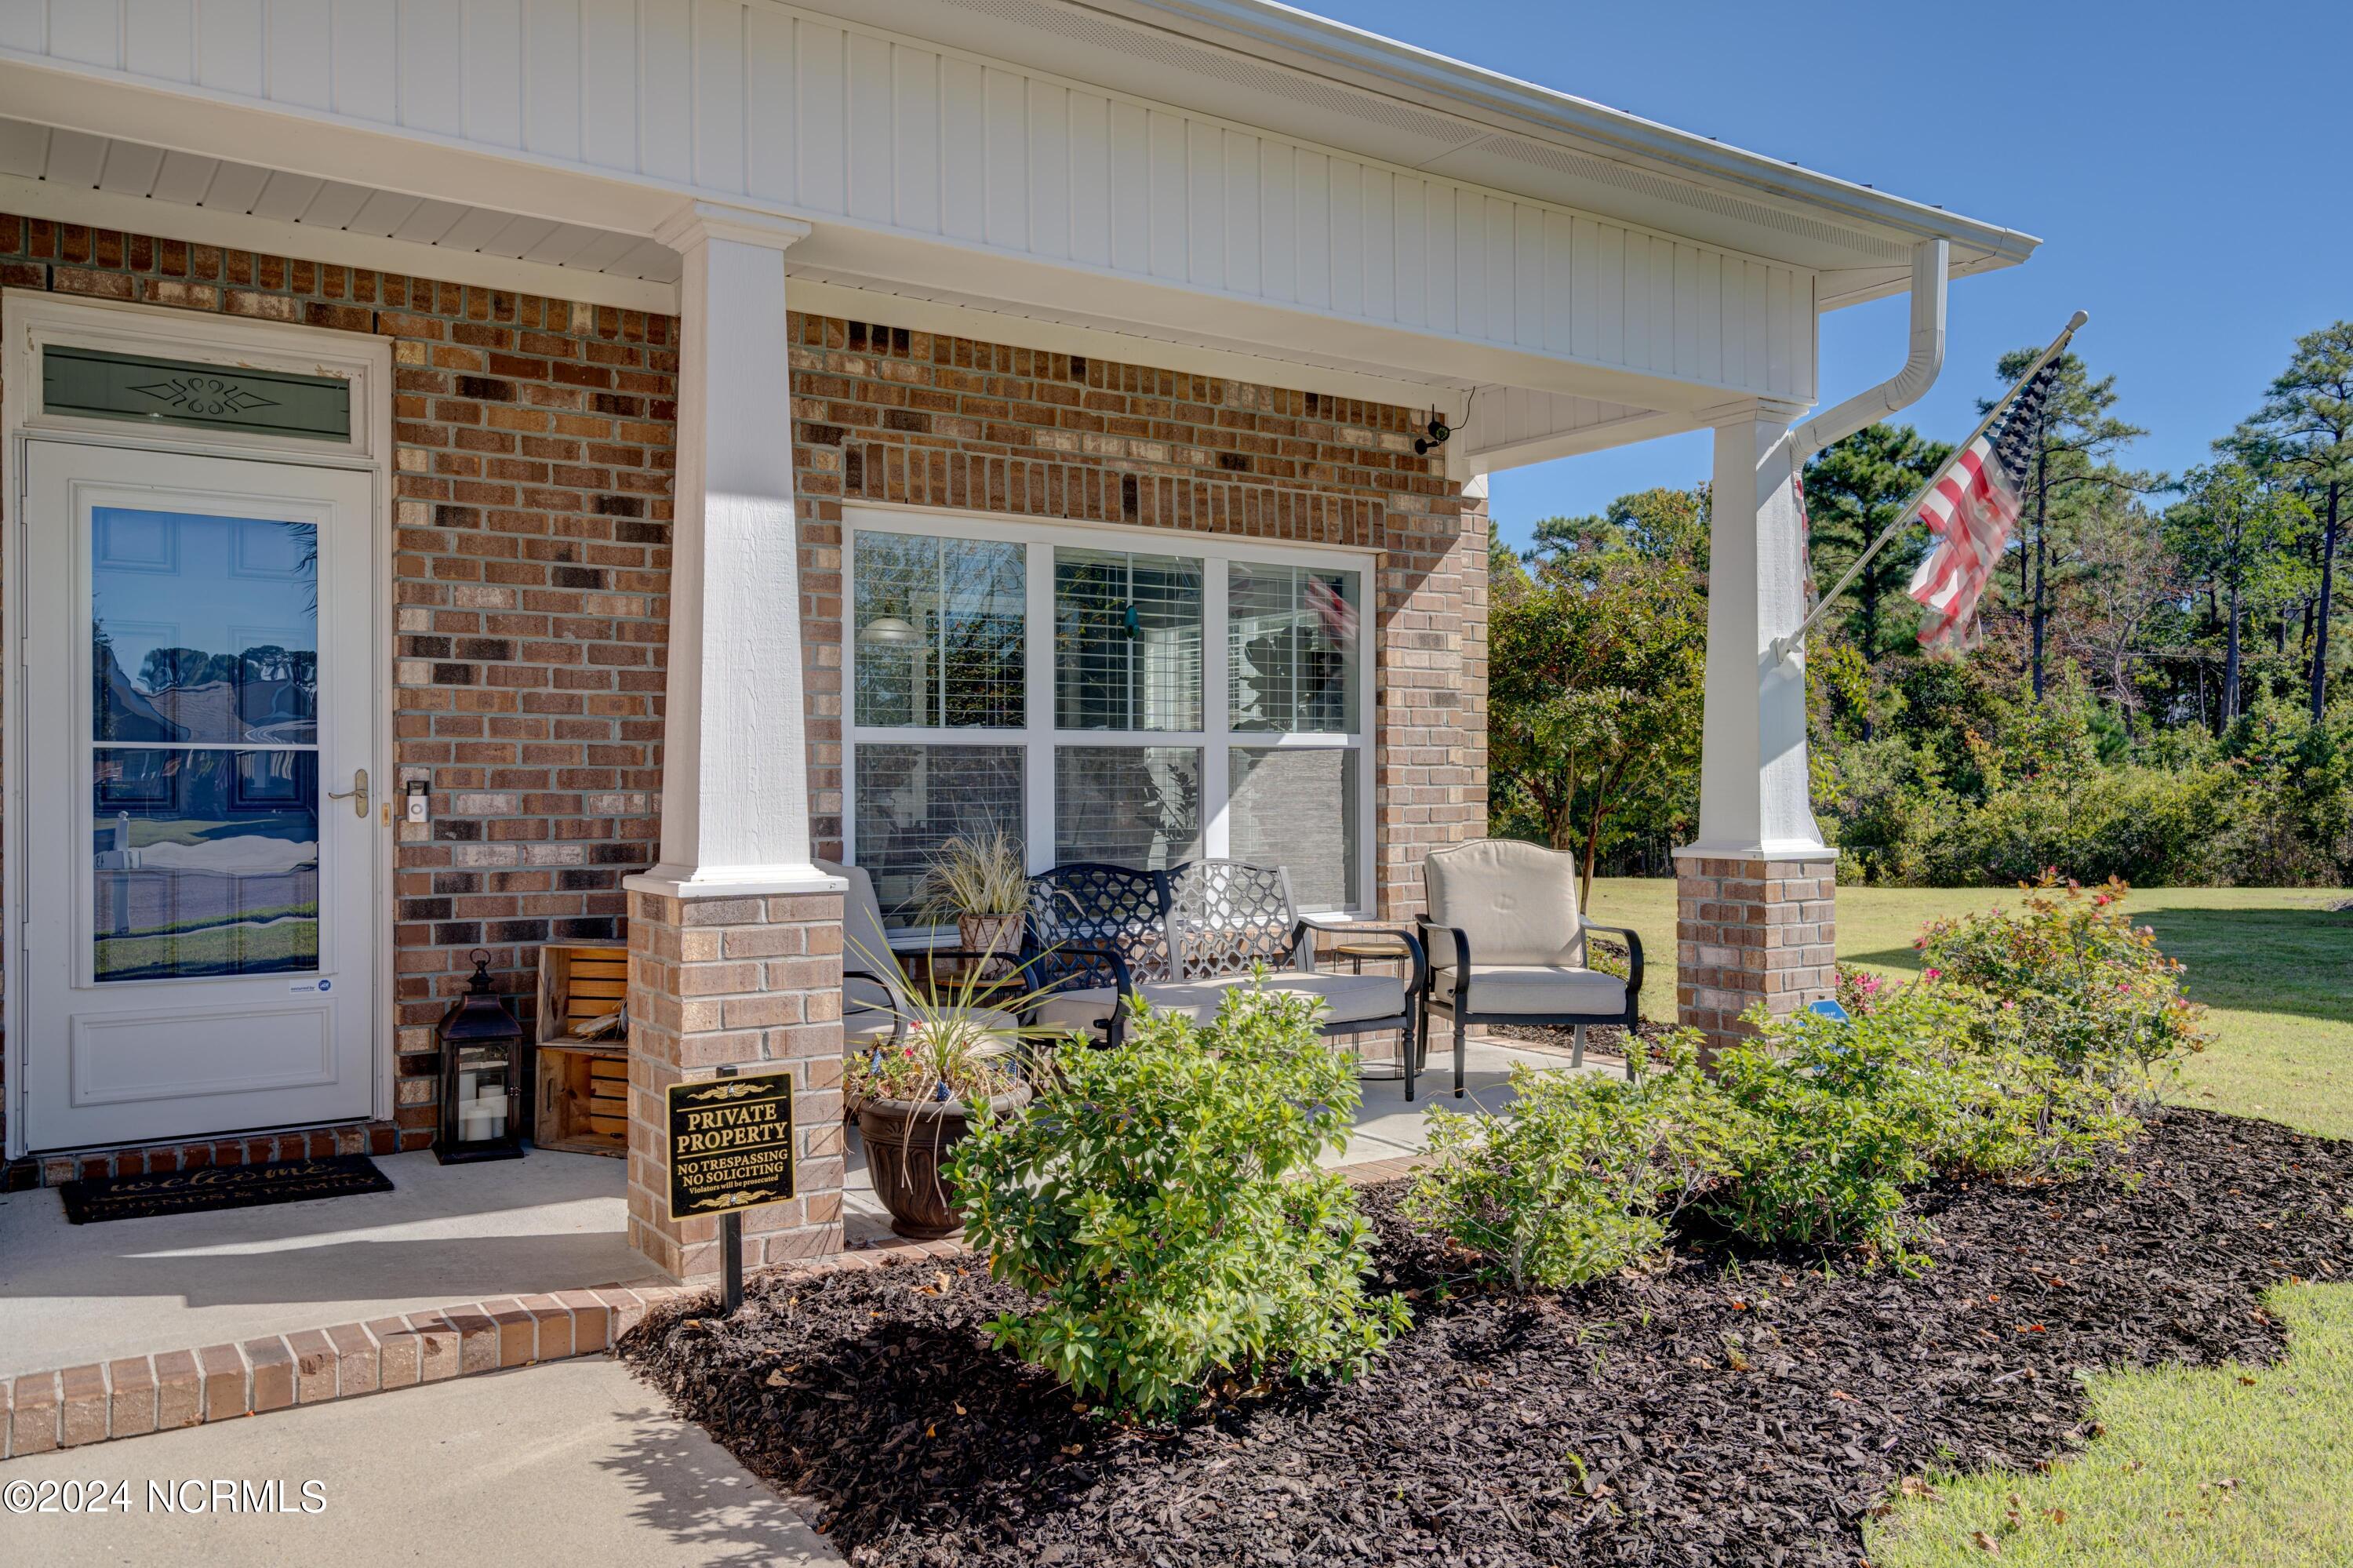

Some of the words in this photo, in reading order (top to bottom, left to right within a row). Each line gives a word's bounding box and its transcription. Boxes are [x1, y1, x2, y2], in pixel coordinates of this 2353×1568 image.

[688, 1104, 776, 1131] PRIVATE
[677, 1122, 787, 1153] PROPERTY
[678, 1162, 699, 1176] NO
[700, 1149, 788, 1172] TRESPASSING
[683, 1174, 704, 1187] NO
[706, 1162, 784, 1184] SOLICITING
[111, 1162, 335, 1191] welcome
[689, 1183, 720, 1195] Violators
[721, 1179, 733, 1190] will
[734, 1178, 742, 1188] be
[743, 1174, 779, 1188] prosecuted
